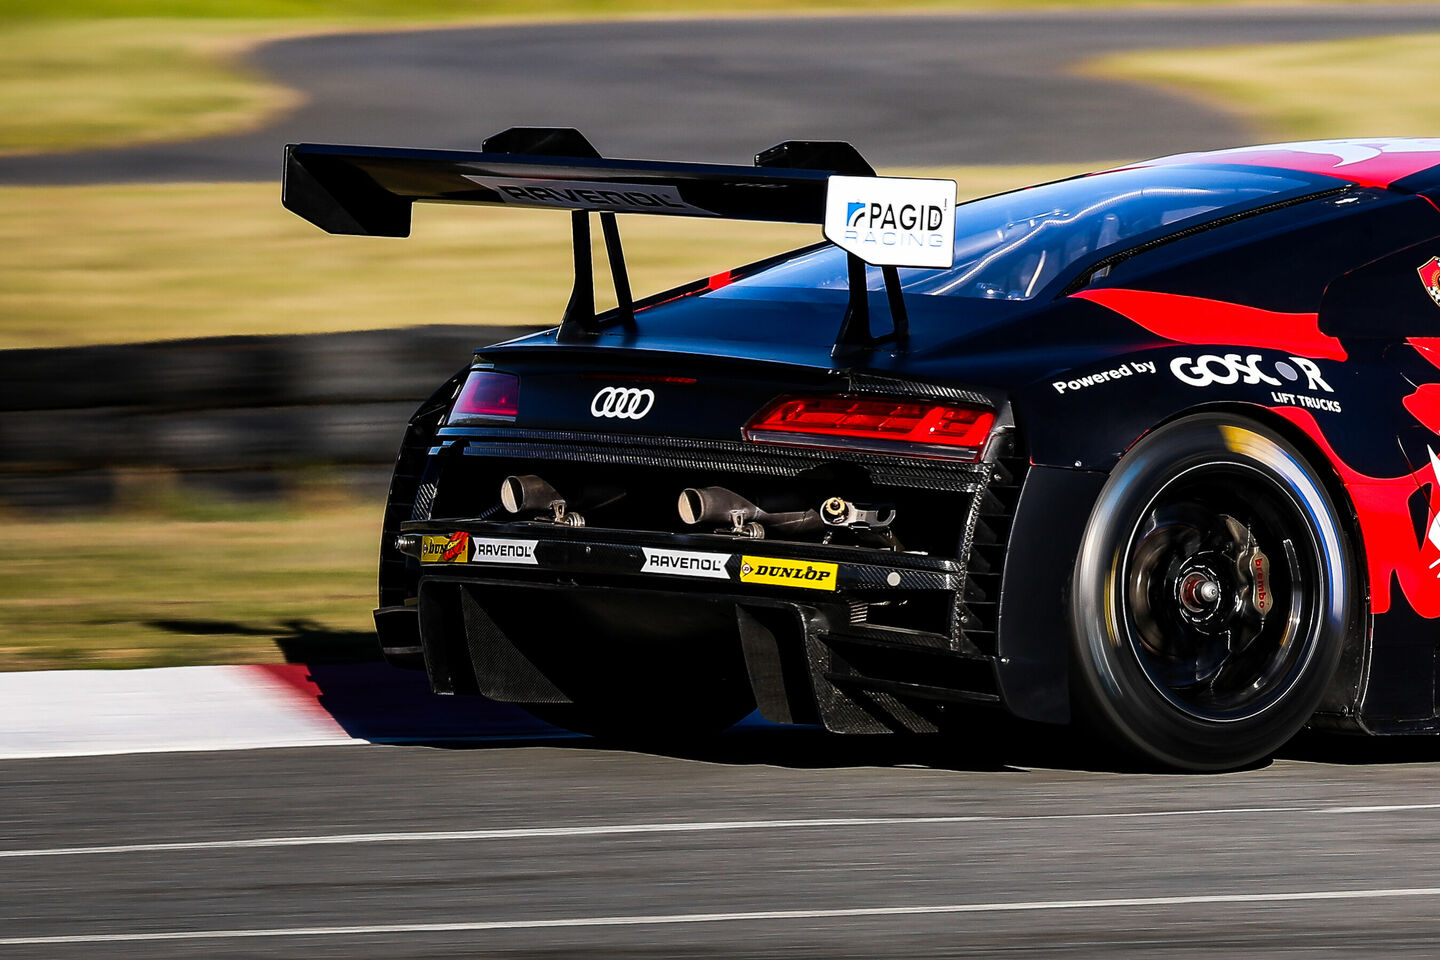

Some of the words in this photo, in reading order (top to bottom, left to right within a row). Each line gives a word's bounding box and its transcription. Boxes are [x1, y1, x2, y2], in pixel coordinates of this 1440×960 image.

[497, 185, 687, 208] RAVENOL
[869, 202, 943, 231] PAGID
[844, 230, 944, 248] RACING
[1052, 365, 1134, 394] Powered
[1133, 360, 1157, 374] by
[1271, 391, 1297, 406] LIFT
[1297, 394, 1342, 414] TRUCKS
[478, 543, 532, 558] RAVENOL
[649, 554, 722, 572] RAVENOL
[754, 564, 831, 582] DUNLOP
